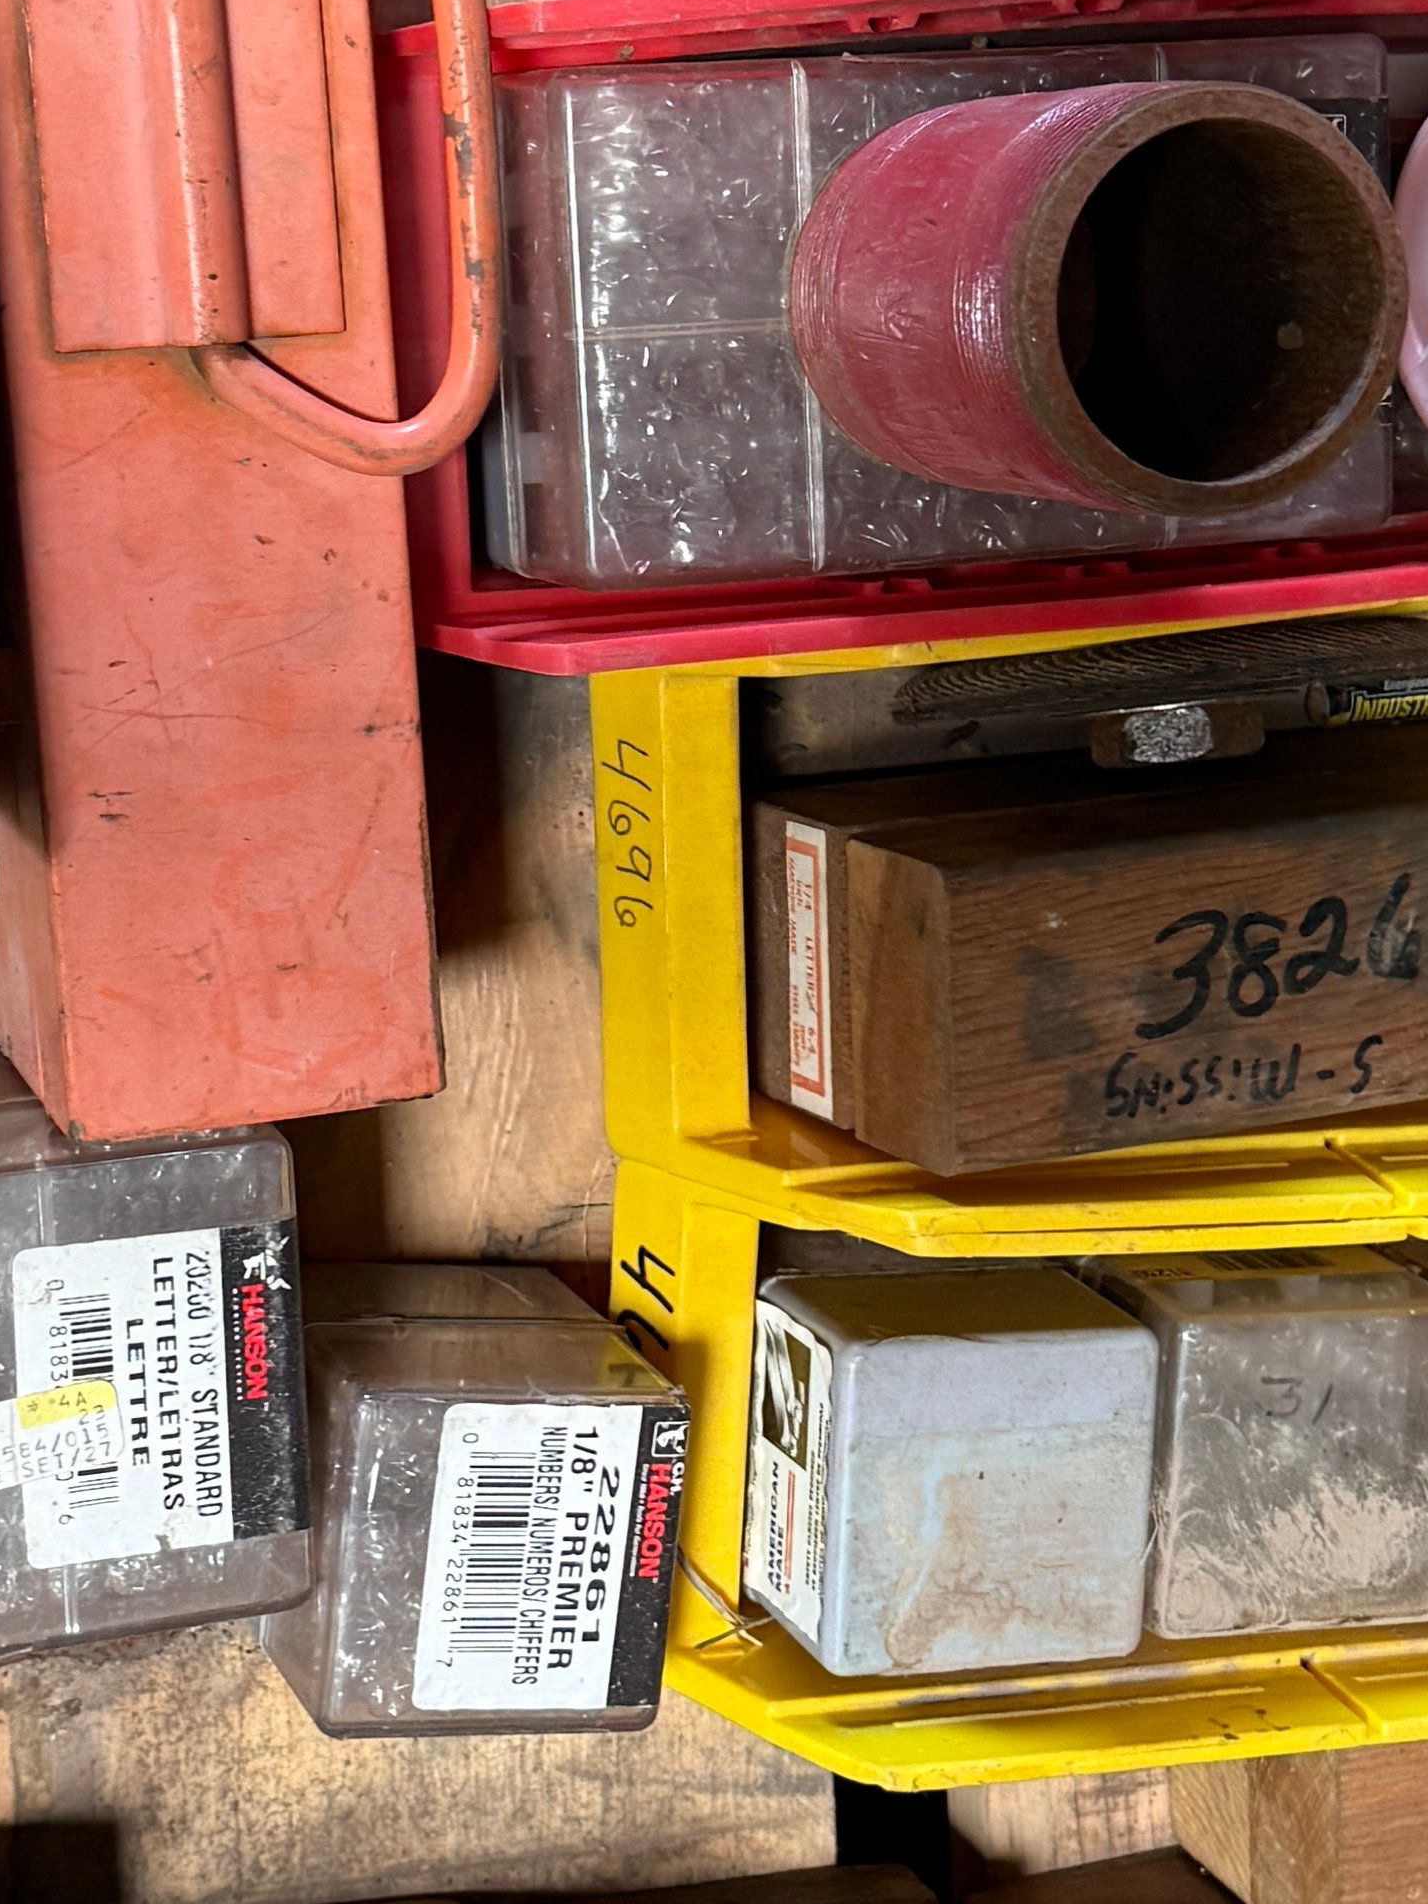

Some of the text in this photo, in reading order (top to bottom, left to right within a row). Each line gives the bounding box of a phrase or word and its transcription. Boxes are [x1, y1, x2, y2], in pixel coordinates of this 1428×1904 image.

[600, 737, 653, 930] 4696
[1135, 872, 1422, 1041] 3826
[127, 1319, 150, 1466] LETTRE
[153, 1257, 184, 1510] LETTER/LETRAS
[241, 1283, 268, 1400] HANSON
[190, 1389, 222, 1517] STANDARD
[639, 1463, 671, 1577] HANSON
[768, 1459, 779, 1585] AMERICAN
[436, 1432, 479, 1668] 0 81834 22861 7
[511, 1426, 567, 1685] NUMBERS/ NUMEROS/ CHIFFERS
[547, 1426, 599, 1669] 1/8" PREMIER
[581, 1465, 621, 1644] 22861
[776, 1525, 784, 1593] MADE
